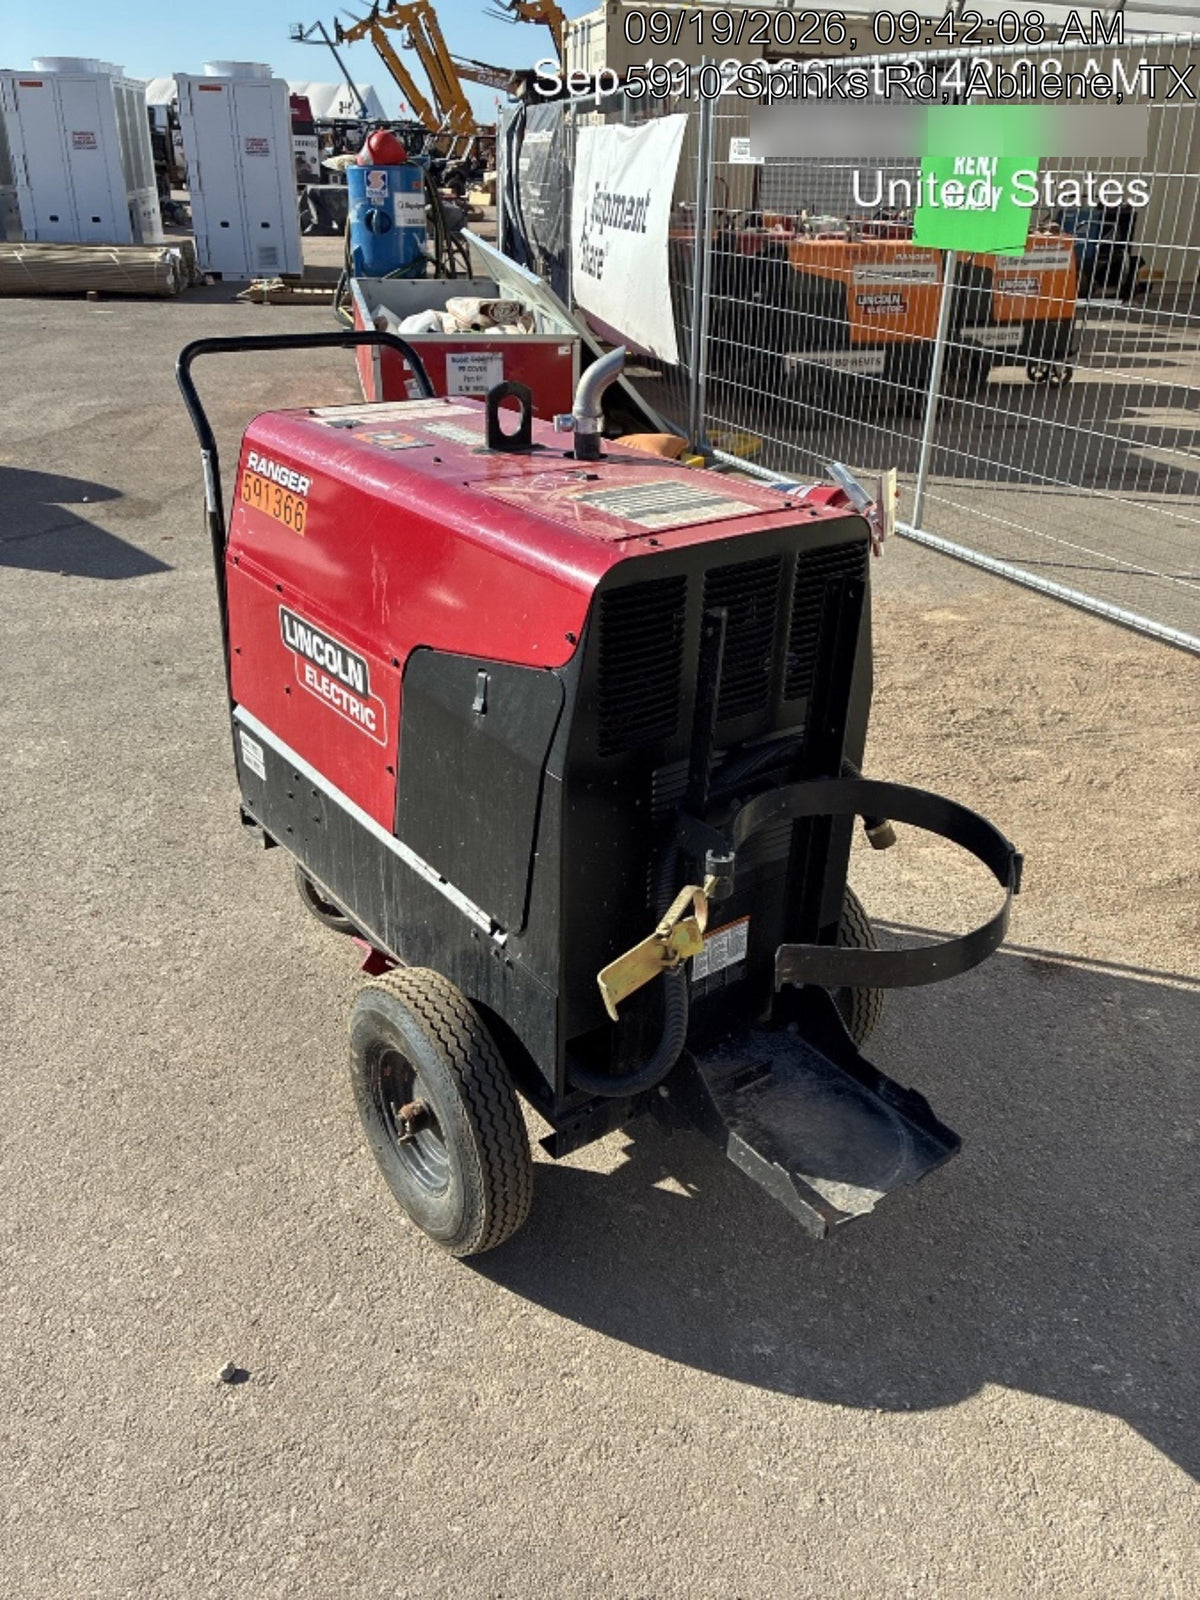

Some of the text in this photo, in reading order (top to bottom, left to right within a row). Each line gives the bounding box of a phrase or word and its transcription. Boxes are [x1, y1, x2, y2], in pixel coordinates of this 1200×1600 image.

[243, 473, 305, 532] 591366
[246, 450, 310, 497] RANGER
[284, 614, 364, 694] LINCOLN
[304, 664, 376, 732] ELECTRIC
